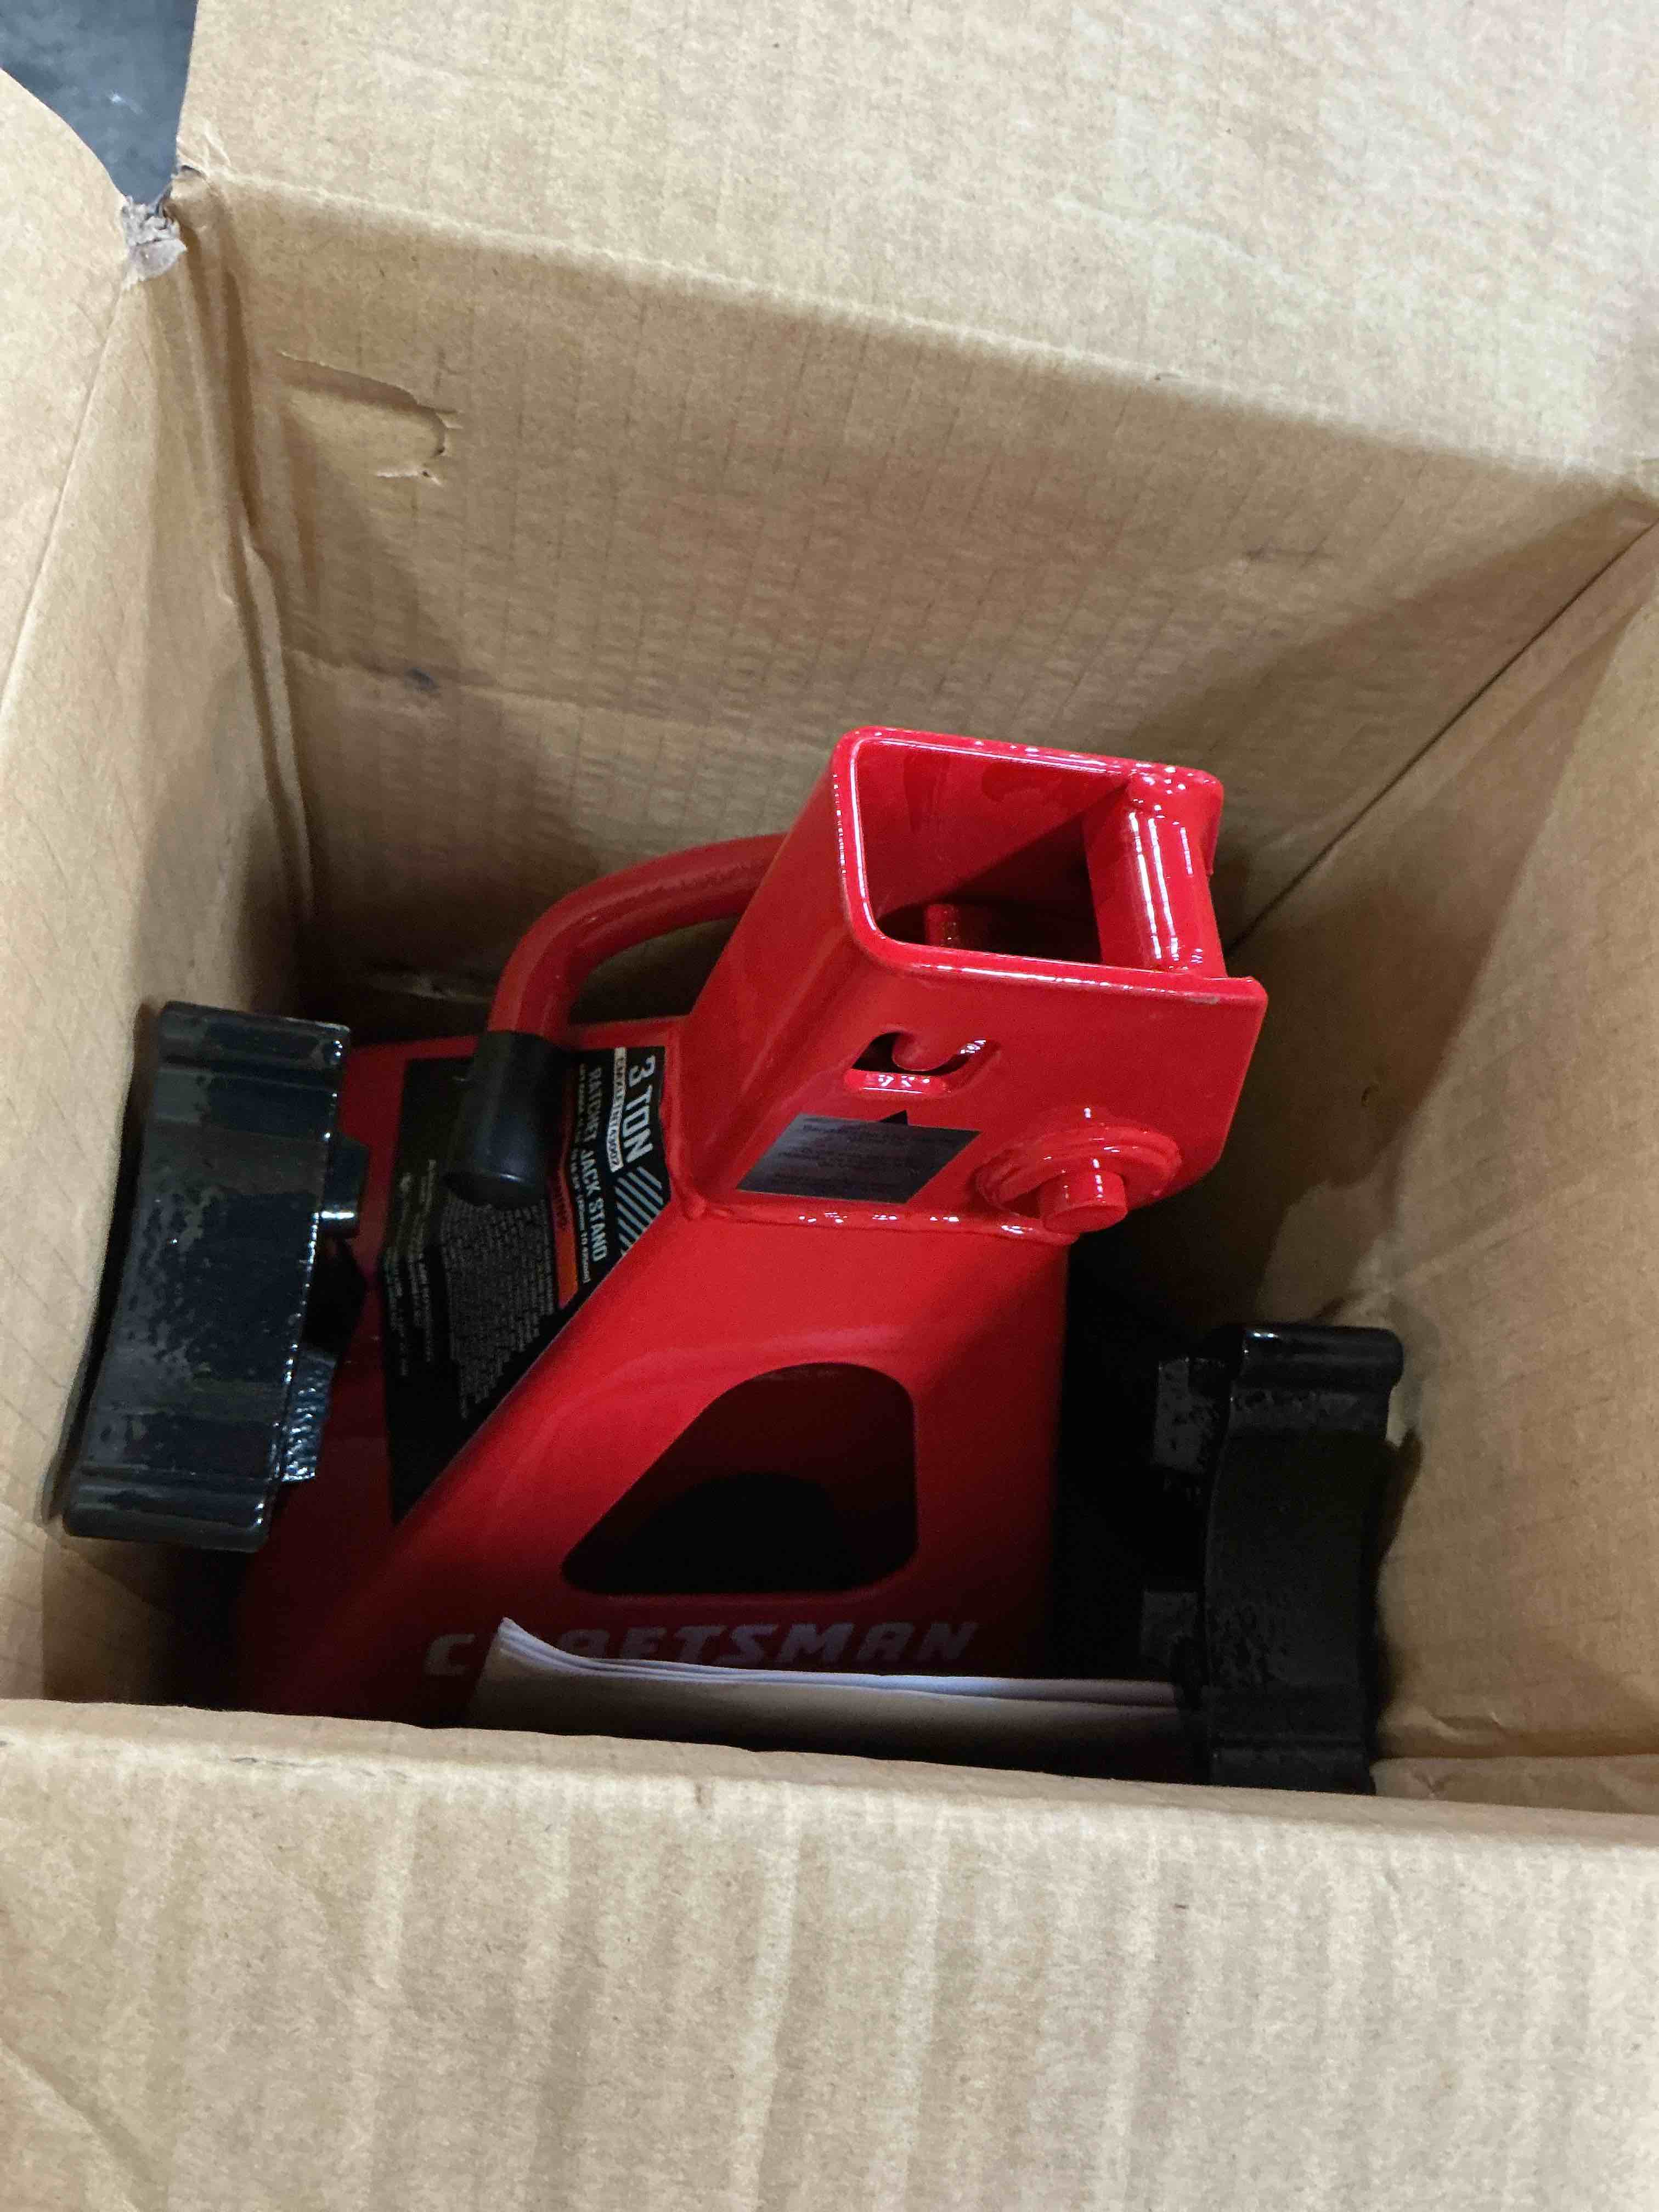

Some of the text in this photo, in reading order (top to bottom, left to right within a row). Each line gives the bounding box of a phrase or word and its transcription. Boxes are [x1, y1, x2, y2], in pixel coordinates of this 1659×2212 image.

[622, 1055, 656, 1163] 3 TON
[580, 1066, 607, 1262] RATCHET JACK STAND
[425, 1621, 979, 1677] CAFTSMAN
